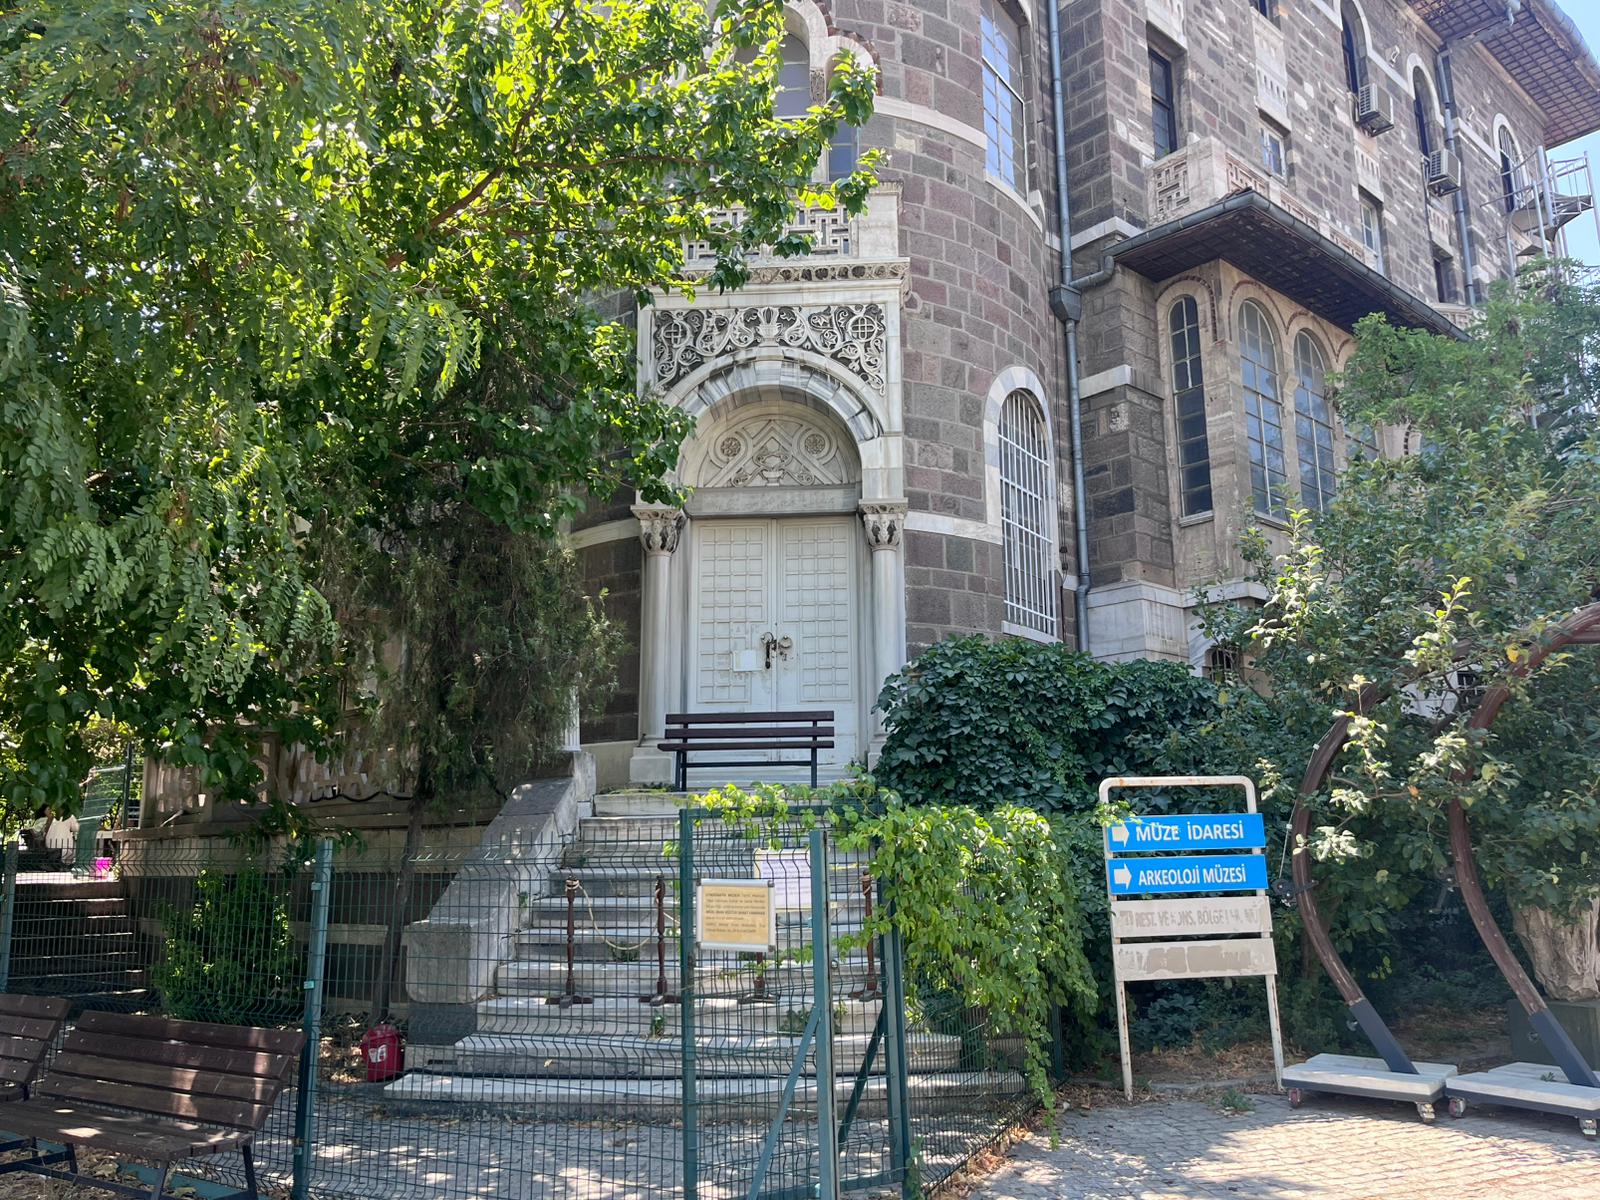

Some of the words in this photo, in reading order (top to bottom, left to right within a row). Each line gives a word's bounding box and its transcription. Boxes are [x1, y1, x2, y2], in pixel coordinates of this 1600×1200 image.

[1136, 822, 1180, 842] MÜZE
[1187, 820, 1244, 840] İDARESİ
[1138, 865, 1200, 886] ARKEOLOJİ
[1203, 863, 1247, 883] MÜZESİ
